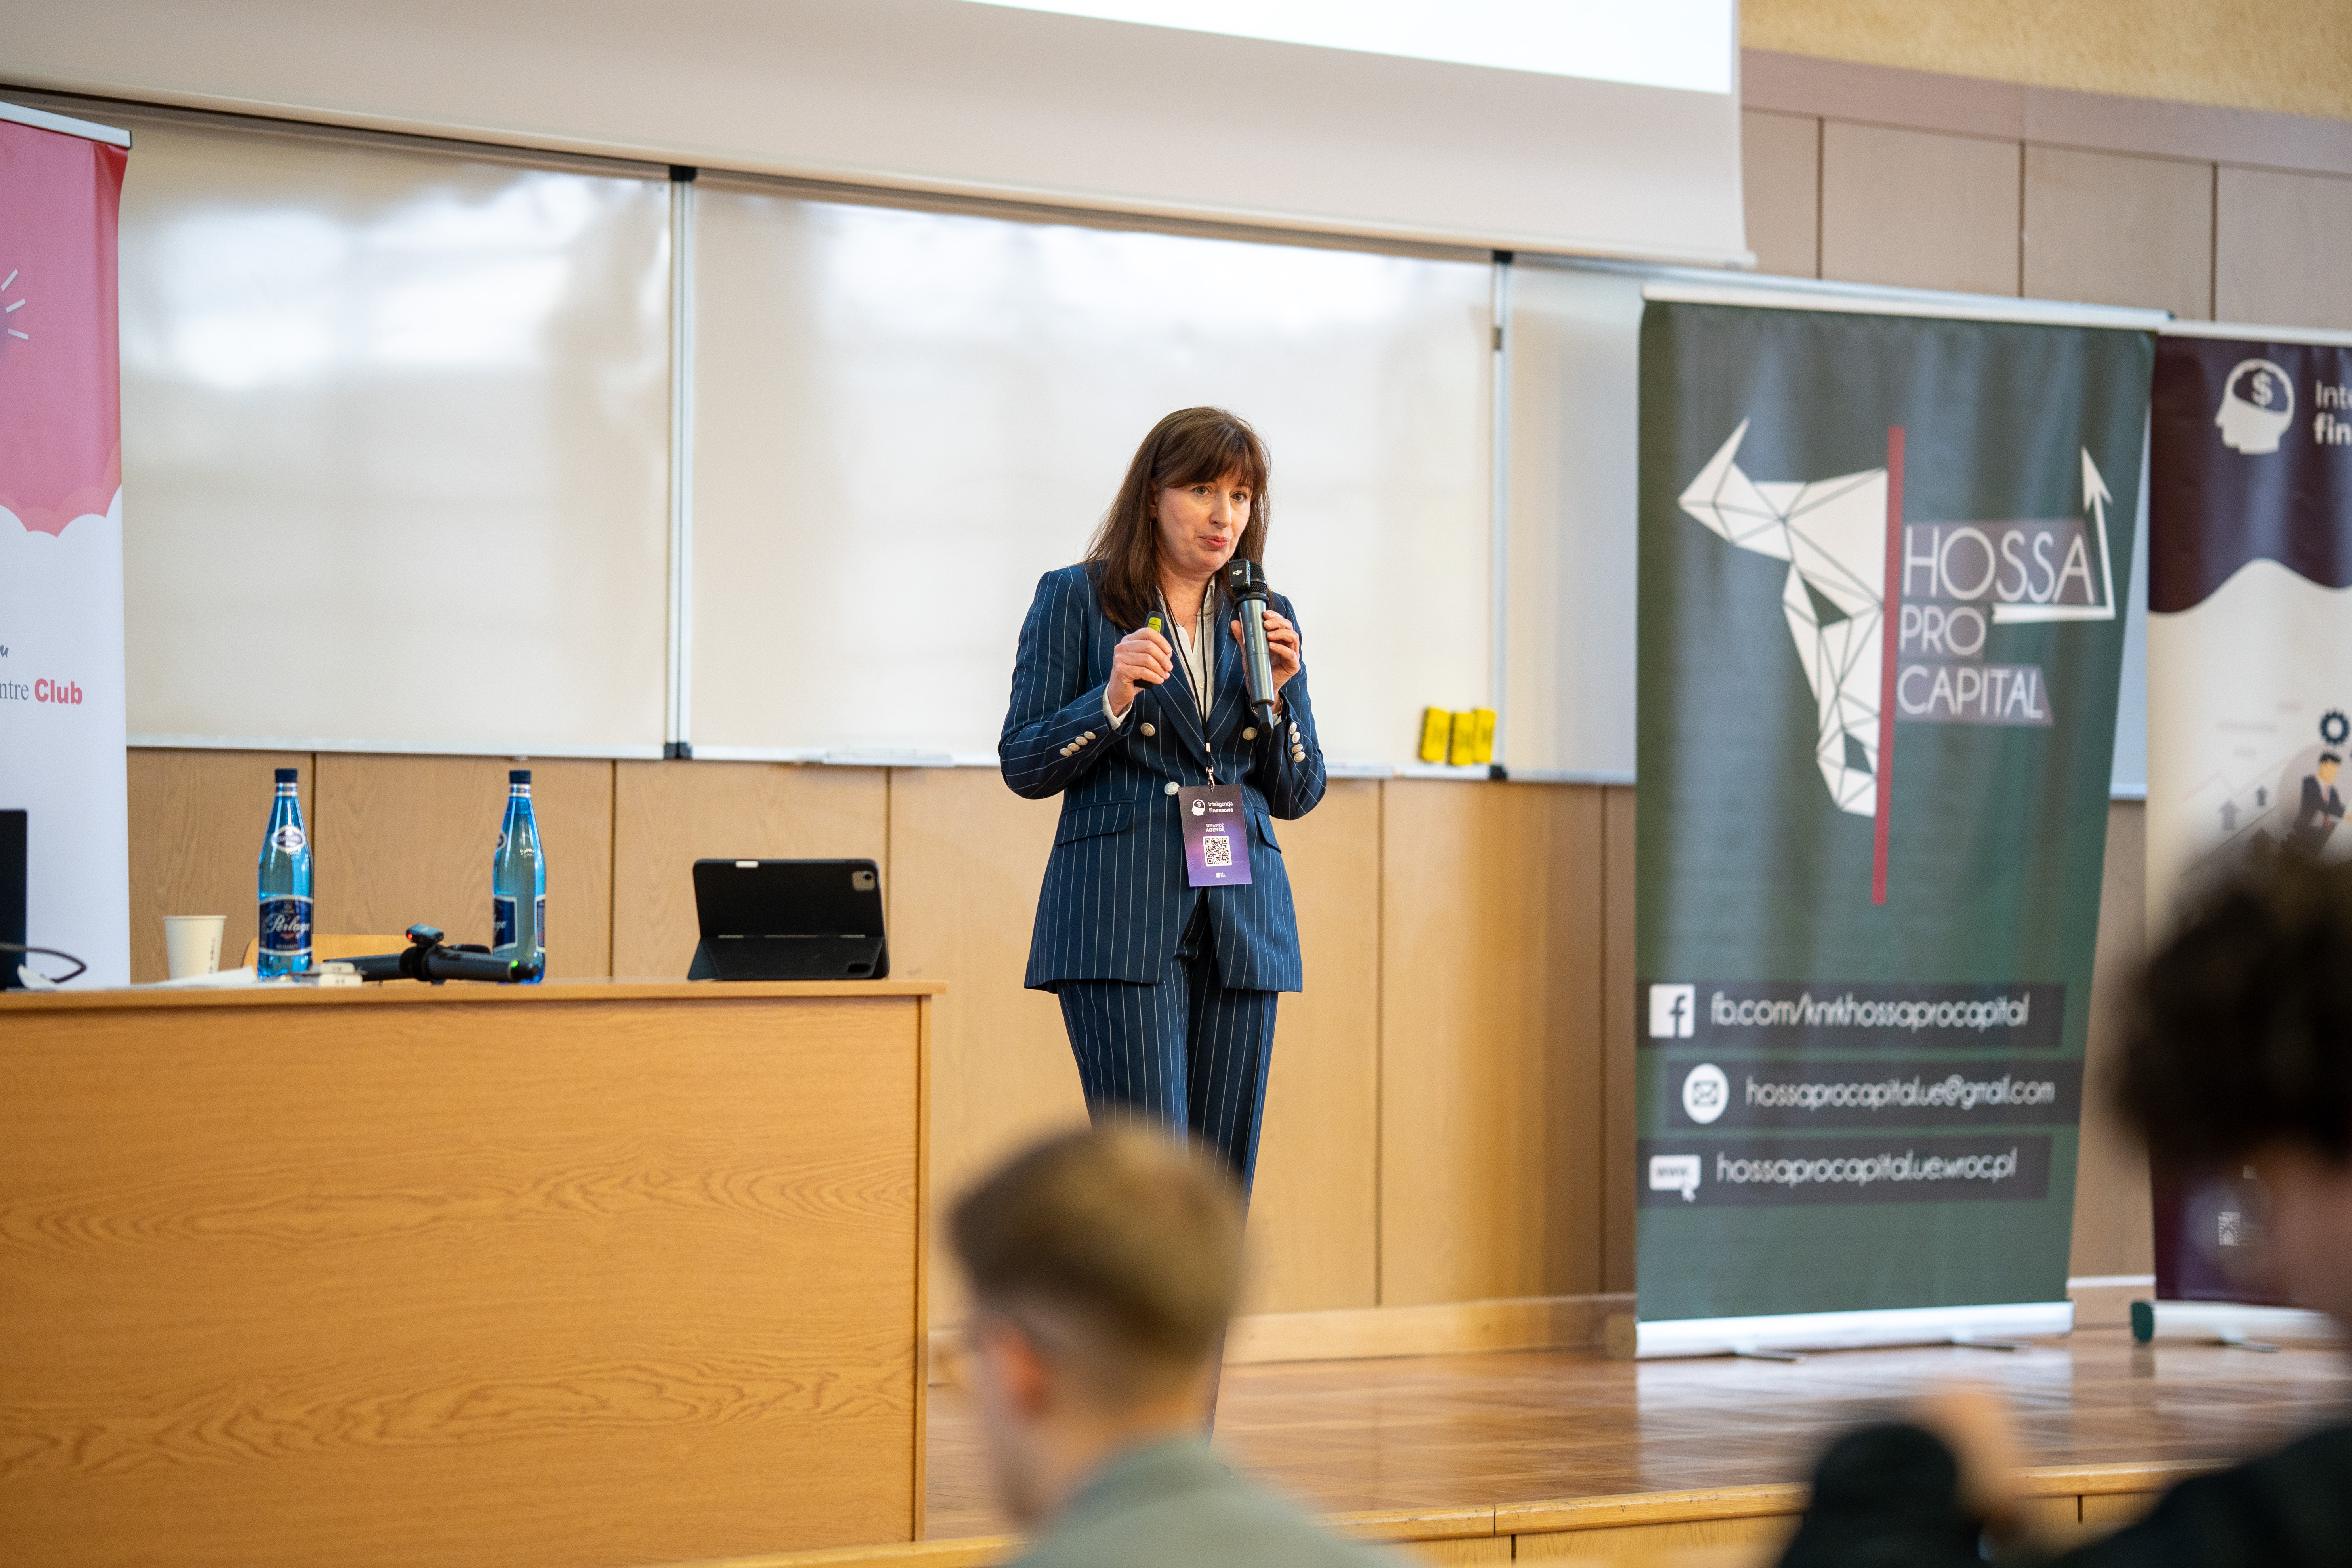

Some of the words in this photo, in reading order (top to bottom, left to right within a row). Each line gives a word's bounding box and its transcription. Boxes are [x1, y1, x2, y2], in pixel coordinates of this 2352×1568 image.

[1903, 524, 2095, 605] HOSSA
[1900, 604, 1987, 656] PRO
[34, 678, 82, 705] Club
[1896, 665, 2045, 719] CAPITAL
